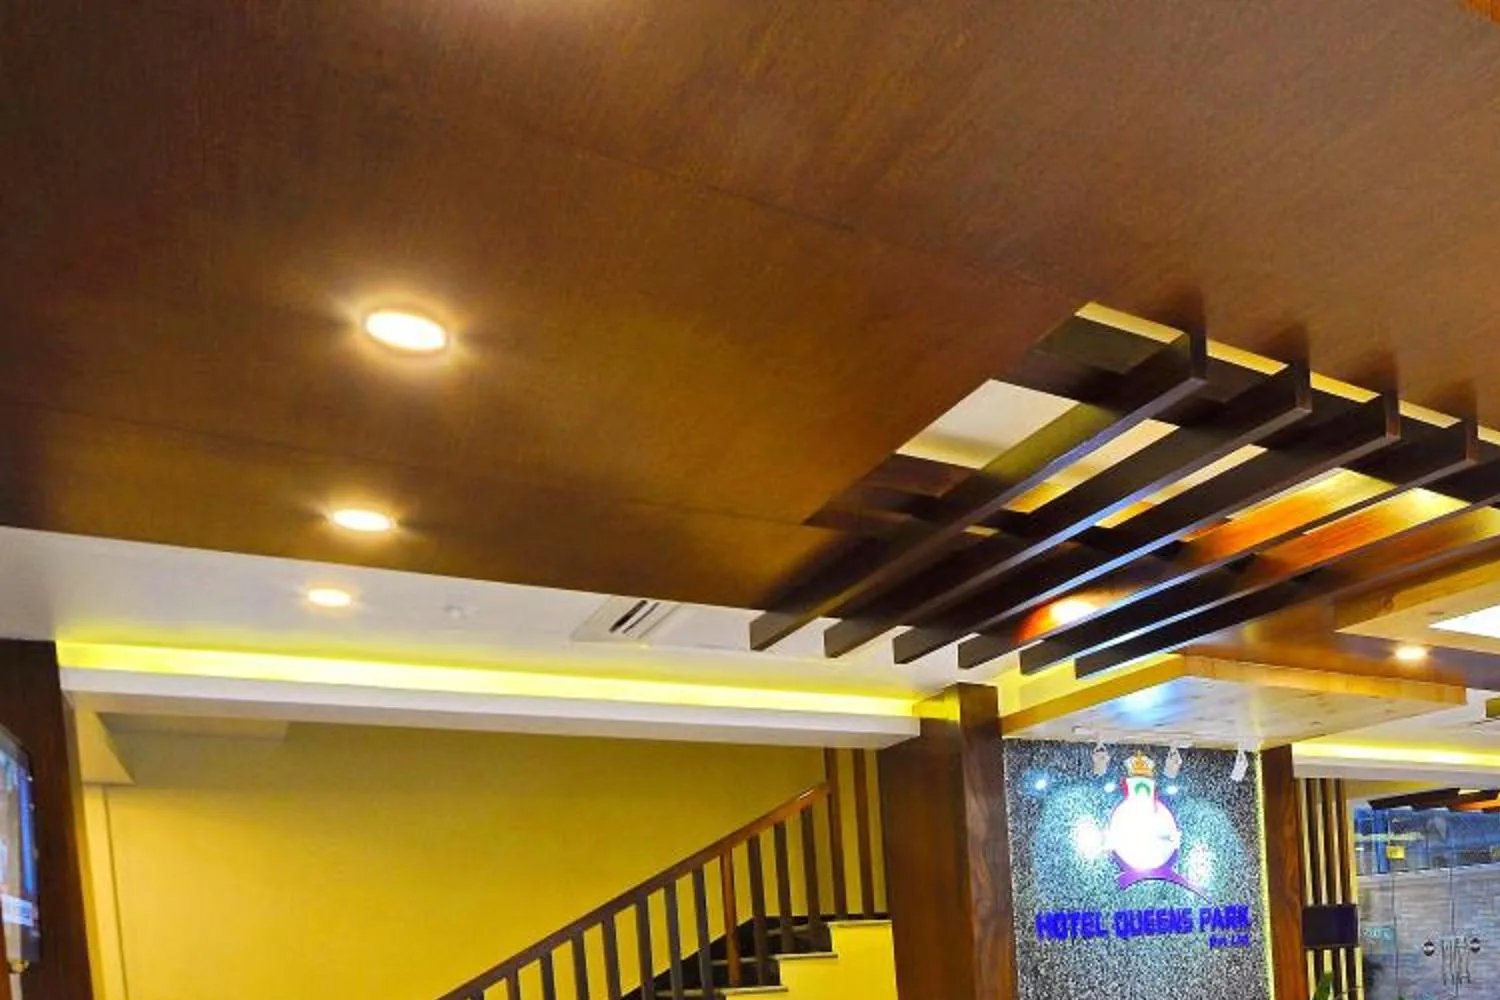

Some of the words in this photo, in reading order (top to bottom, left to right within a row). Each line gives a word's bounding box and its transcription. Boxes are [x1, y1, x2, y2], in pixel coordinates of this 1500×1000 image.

[1035, 910, 1109, 941] HOTEL
[1114, 907, 1193, 940] QUEENS
[1198, 904, 1249, 931] PARK
